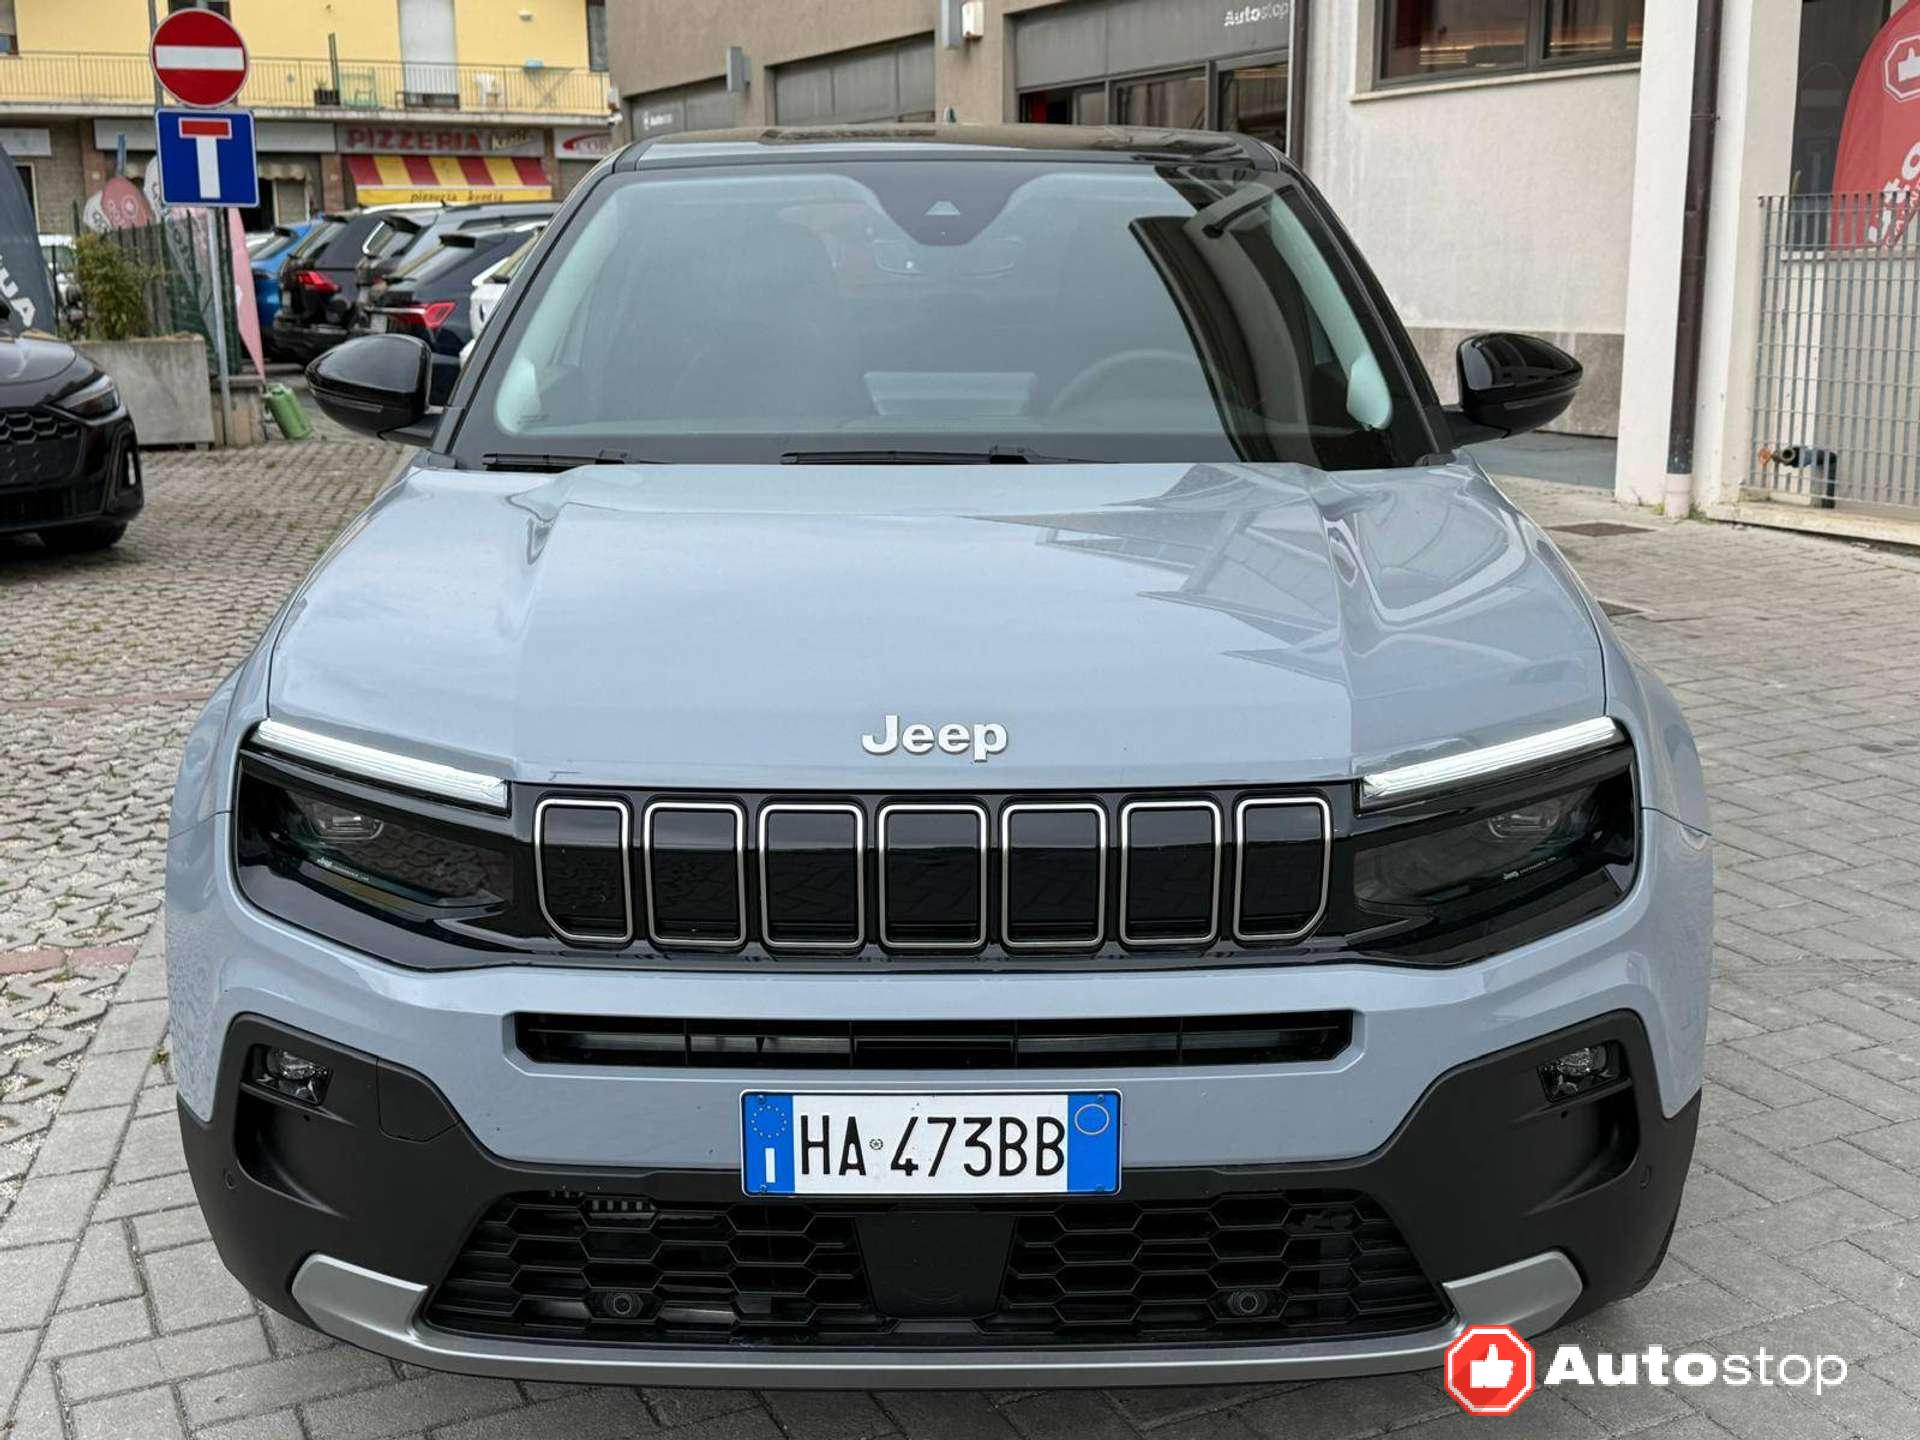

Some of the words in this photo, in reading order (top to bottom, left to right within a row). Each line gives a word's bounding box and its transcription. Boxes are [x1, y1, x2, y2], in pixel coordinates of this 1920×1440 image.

[1224, 3, 1289, 26] Autostop
[347, 128, 481, 150] PIZZERIA
[862, 714, 1009, 763] Jeep
